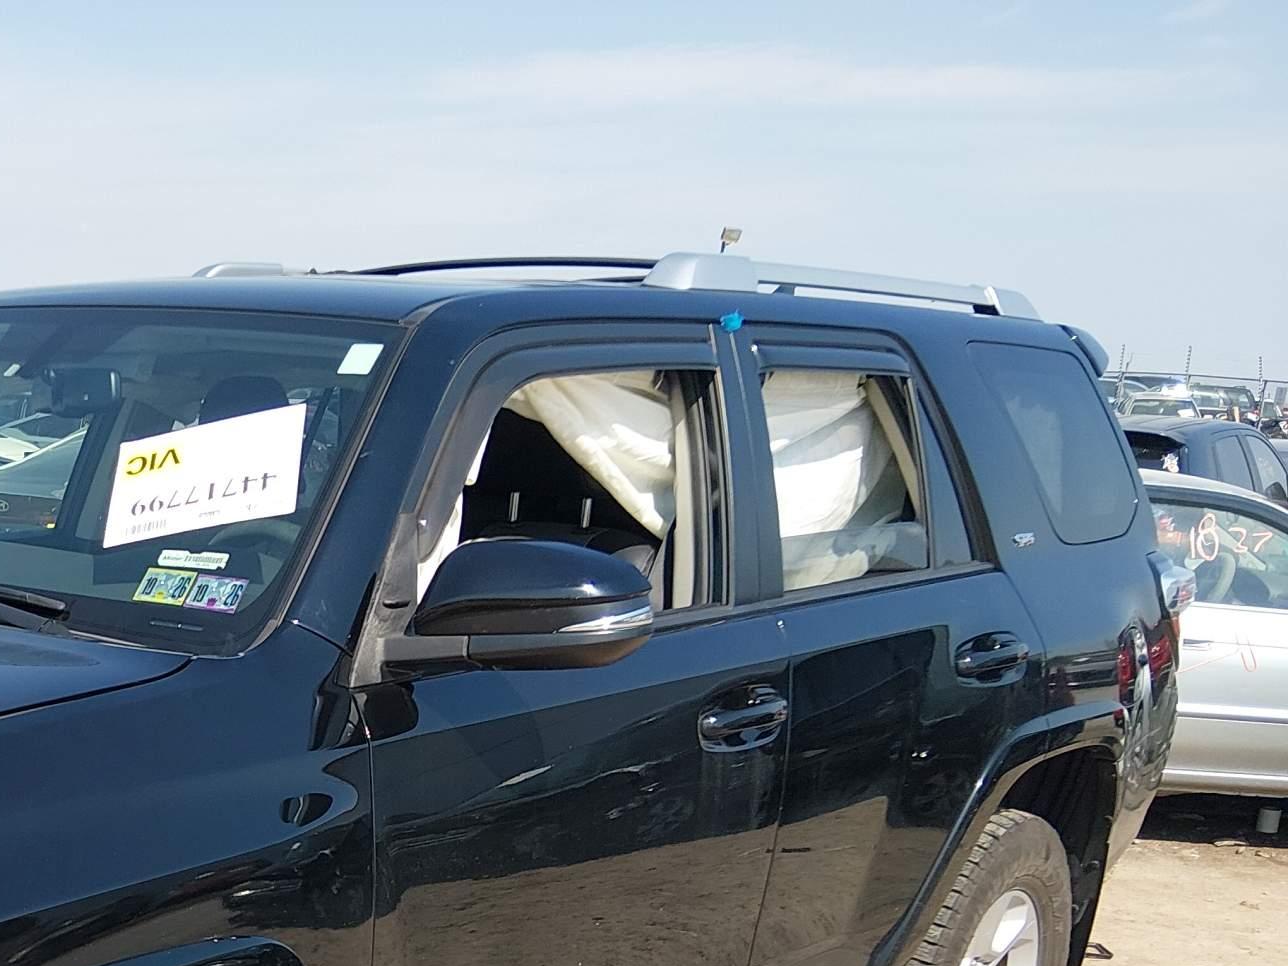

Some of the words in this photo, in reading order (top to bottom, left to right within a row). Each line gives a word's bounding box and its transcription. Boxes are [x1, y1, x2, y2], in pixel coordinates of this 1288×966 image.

[126, 448, 180, 476] VIC
[131, 472, 277, 516] 44717799
[141, 577, 158, 595] 10
[172, 576, 191, 598] 26
[192, 584, 209, 602] 10
[223, 583, 244, 606] 26
